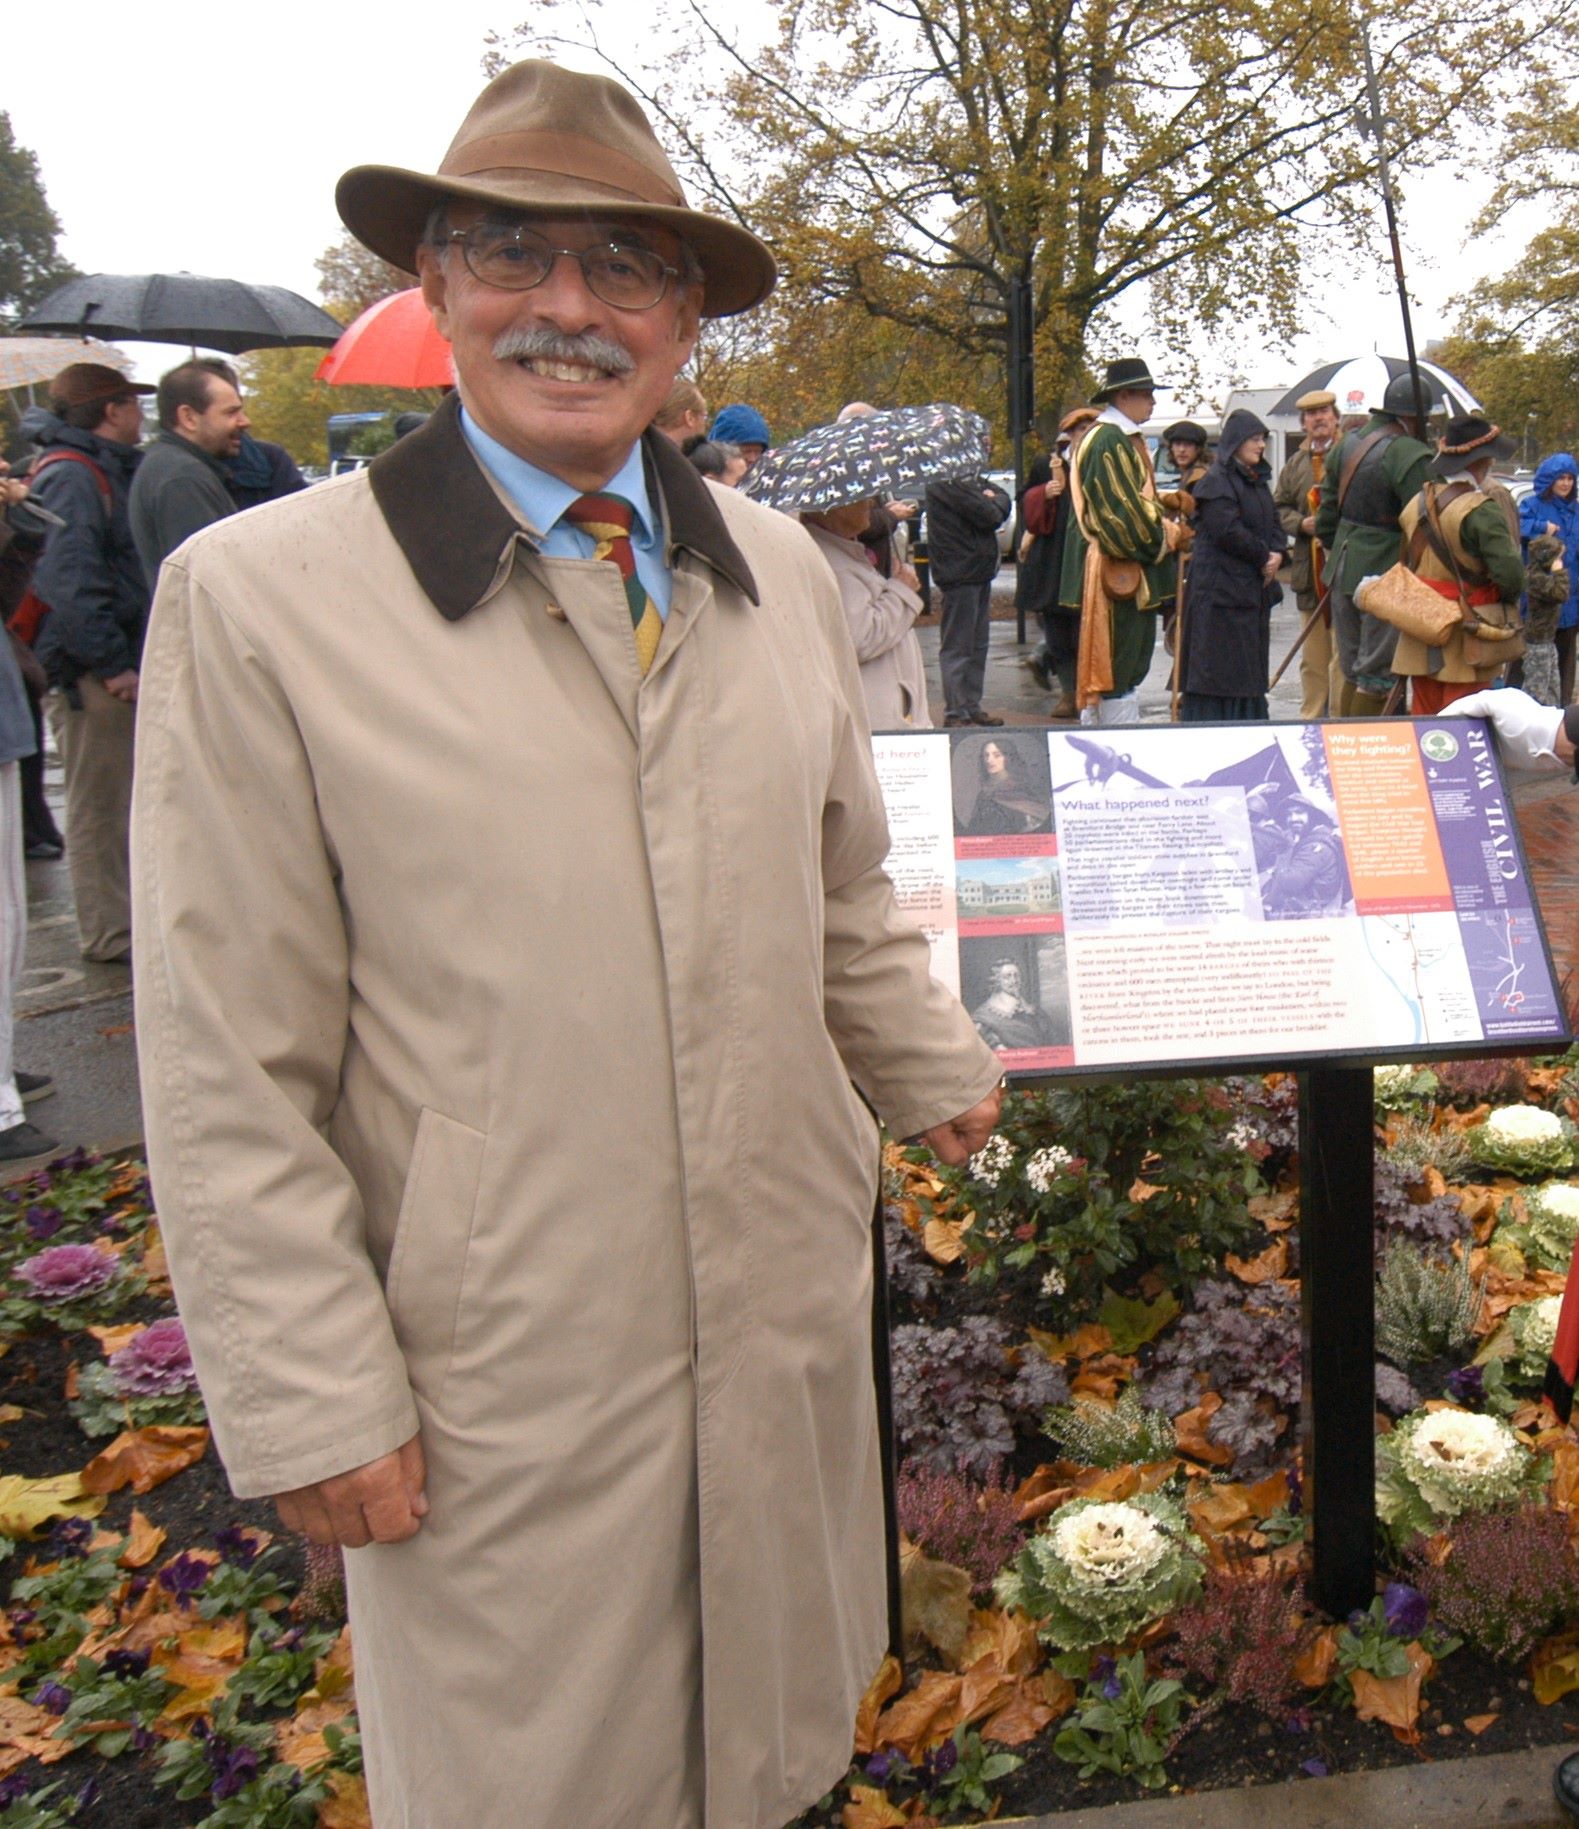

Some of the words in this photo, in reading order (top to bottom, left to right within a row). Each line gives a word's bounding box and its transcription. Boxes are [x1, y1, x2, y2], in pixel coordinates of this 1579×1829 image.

[1329, 735, 1356, 745] Why
[1332, 747, 1357, 757] they
[1360, 744, 1411, 756] fighting?
[1467, 730, 1495, 790] WAR
[1062, 800, 1101, 811] What
[1105, 798, 1170, 813] happened
[1176, 796, 1209, 808] next?
[1484, 799, 1518, 880] CIVIL
[1480, 840, 1503, 884] ENGLISH
[1491, 884, 1508, 906] THE
